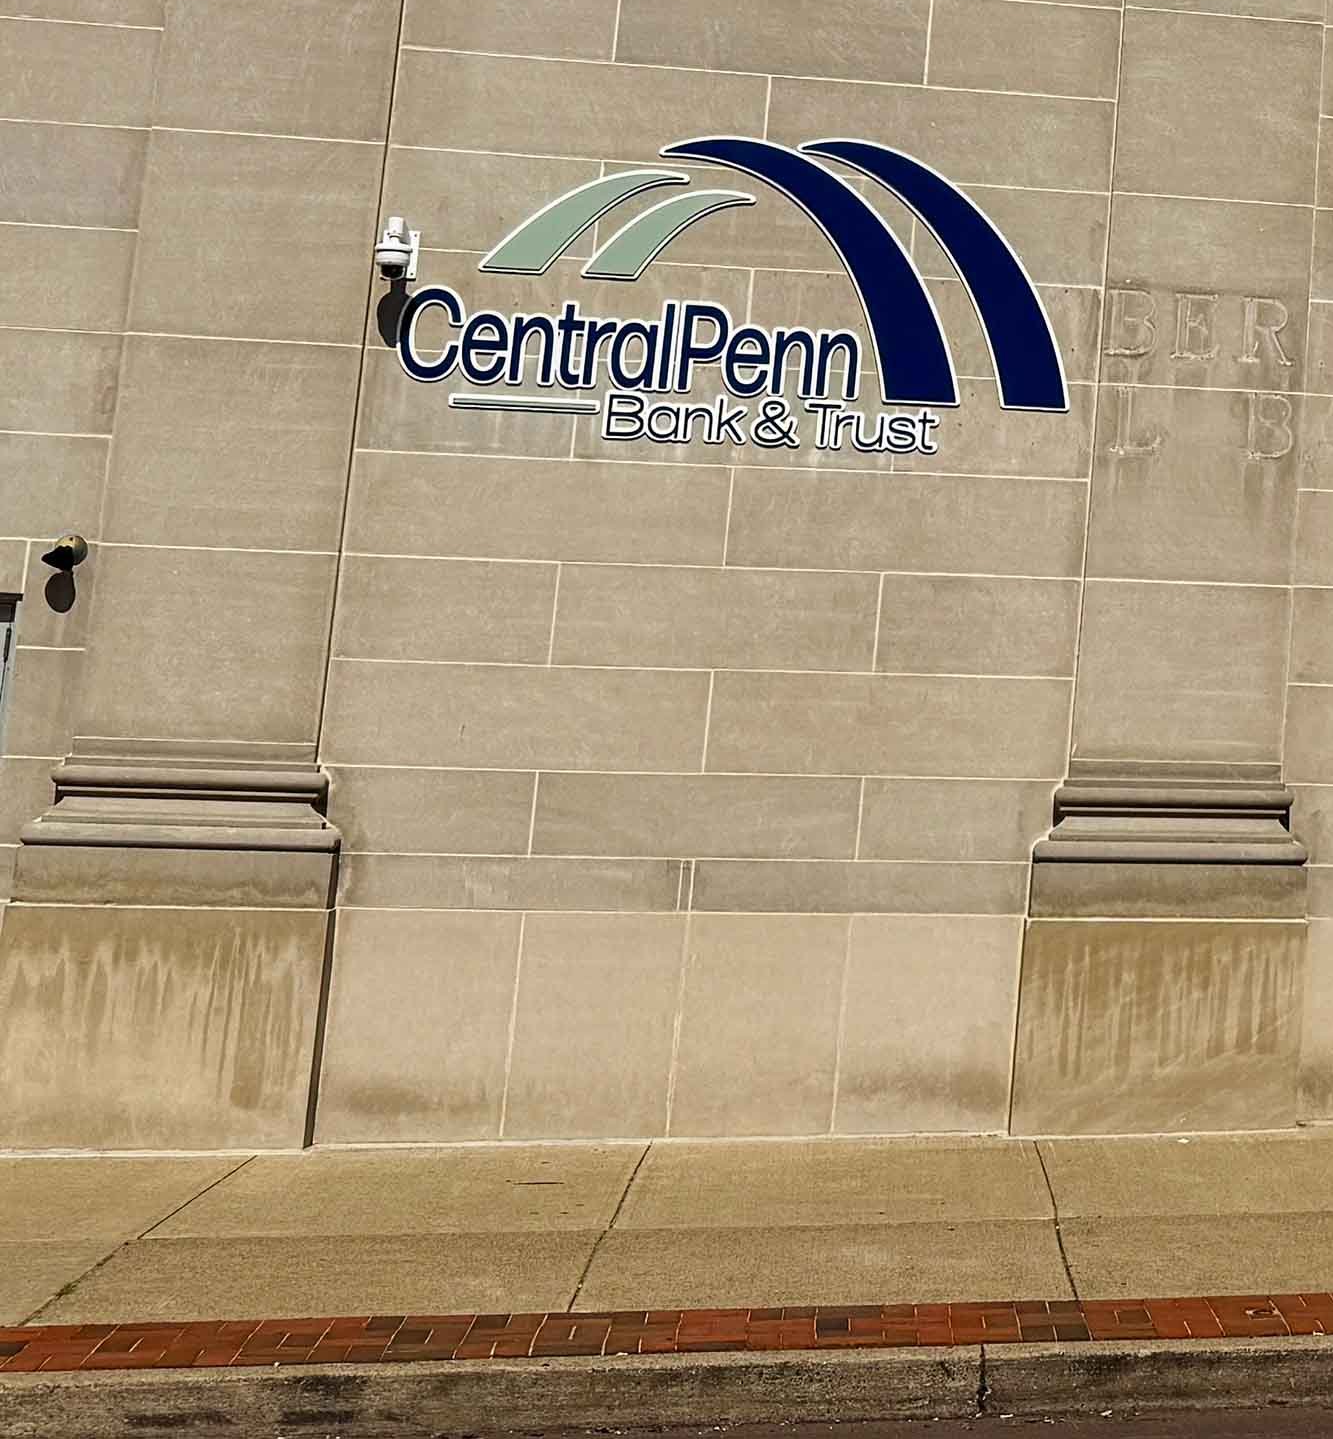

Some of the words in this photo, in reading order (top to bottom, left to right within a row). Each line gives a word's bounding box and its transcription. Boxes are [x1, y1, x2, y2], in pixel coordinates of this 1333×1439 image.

[400, 286, 861, 401] CentralPenn
[602, 393, 745, 445] Bank
[755, 398, 799, 448] &
[808, 400, 940, 454] Trust
